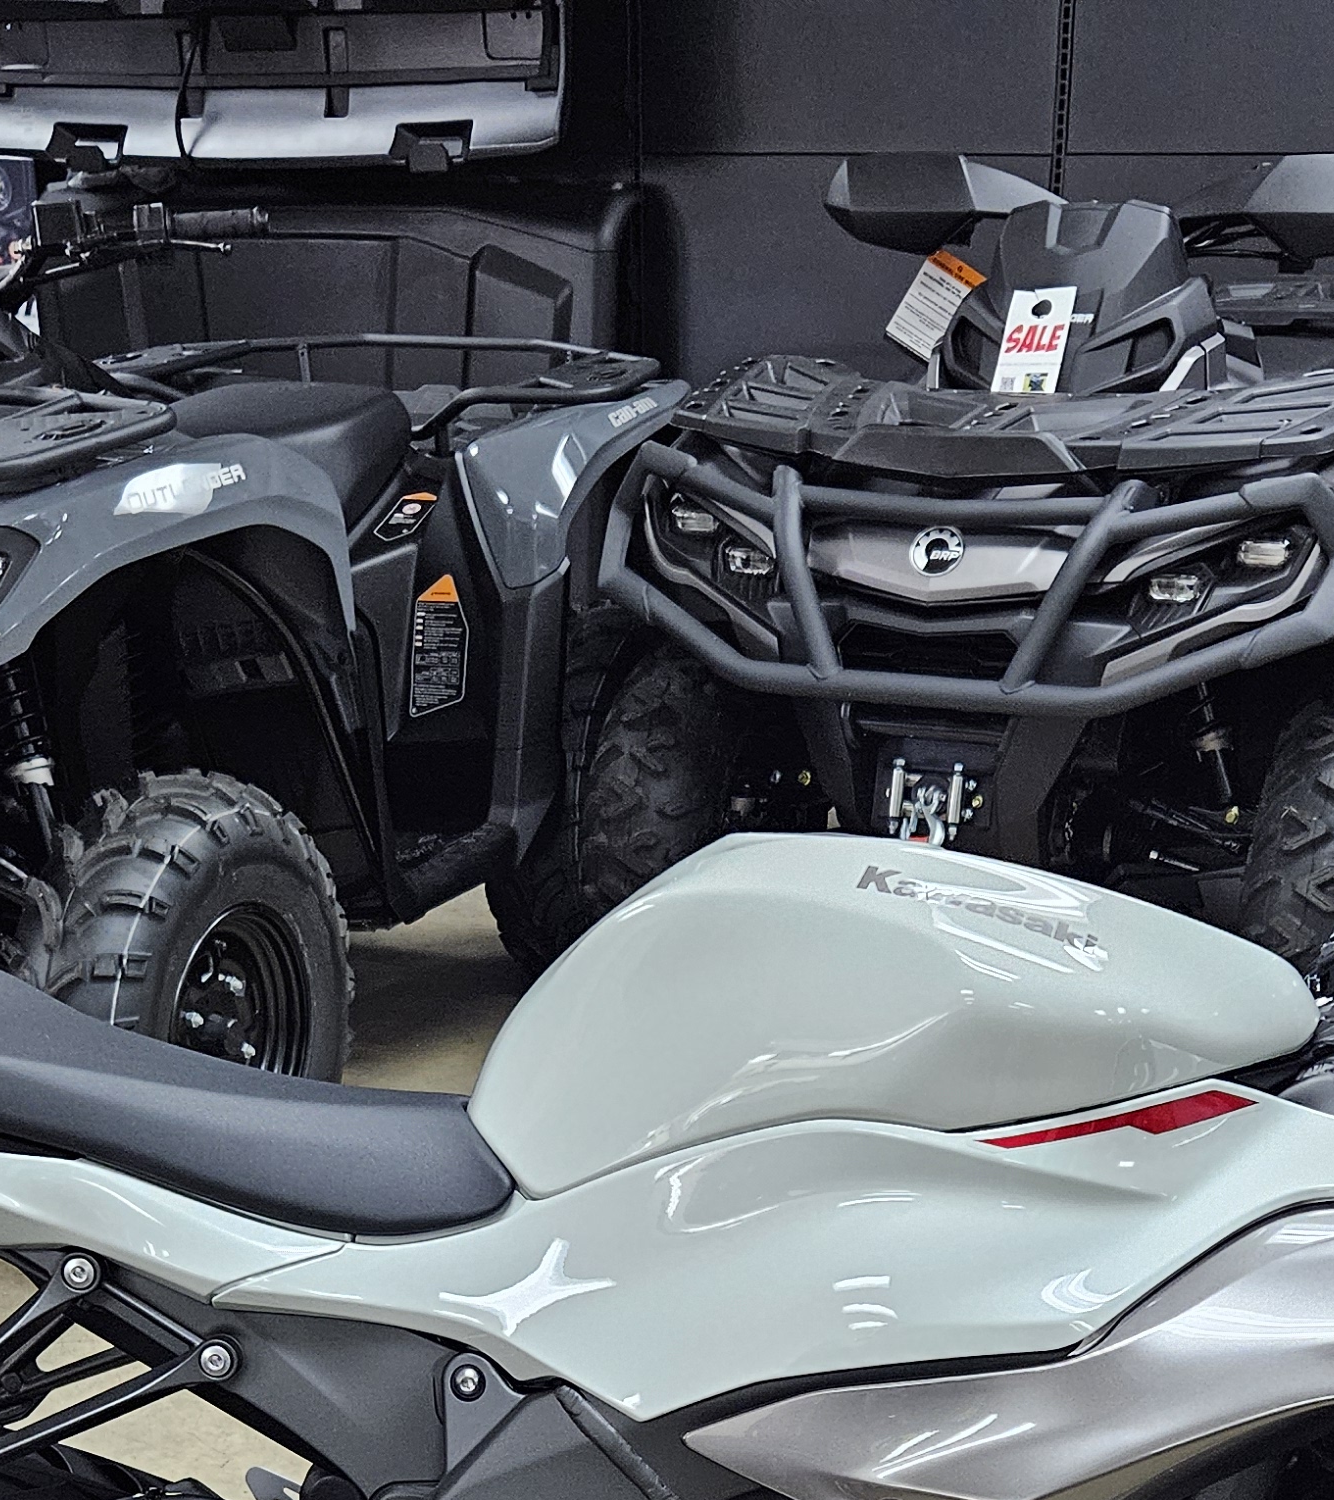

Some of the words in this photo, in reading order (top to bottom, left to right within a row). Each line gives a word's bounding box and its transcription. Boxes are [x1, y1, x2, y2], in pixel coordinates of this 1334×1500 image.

[1004, 323, 1066, 354] SALE
[607, 396, 659, 428] can-am
[929, 549, 962, 561] BRP
[856, 865, 1101, 952] Kawasaki
